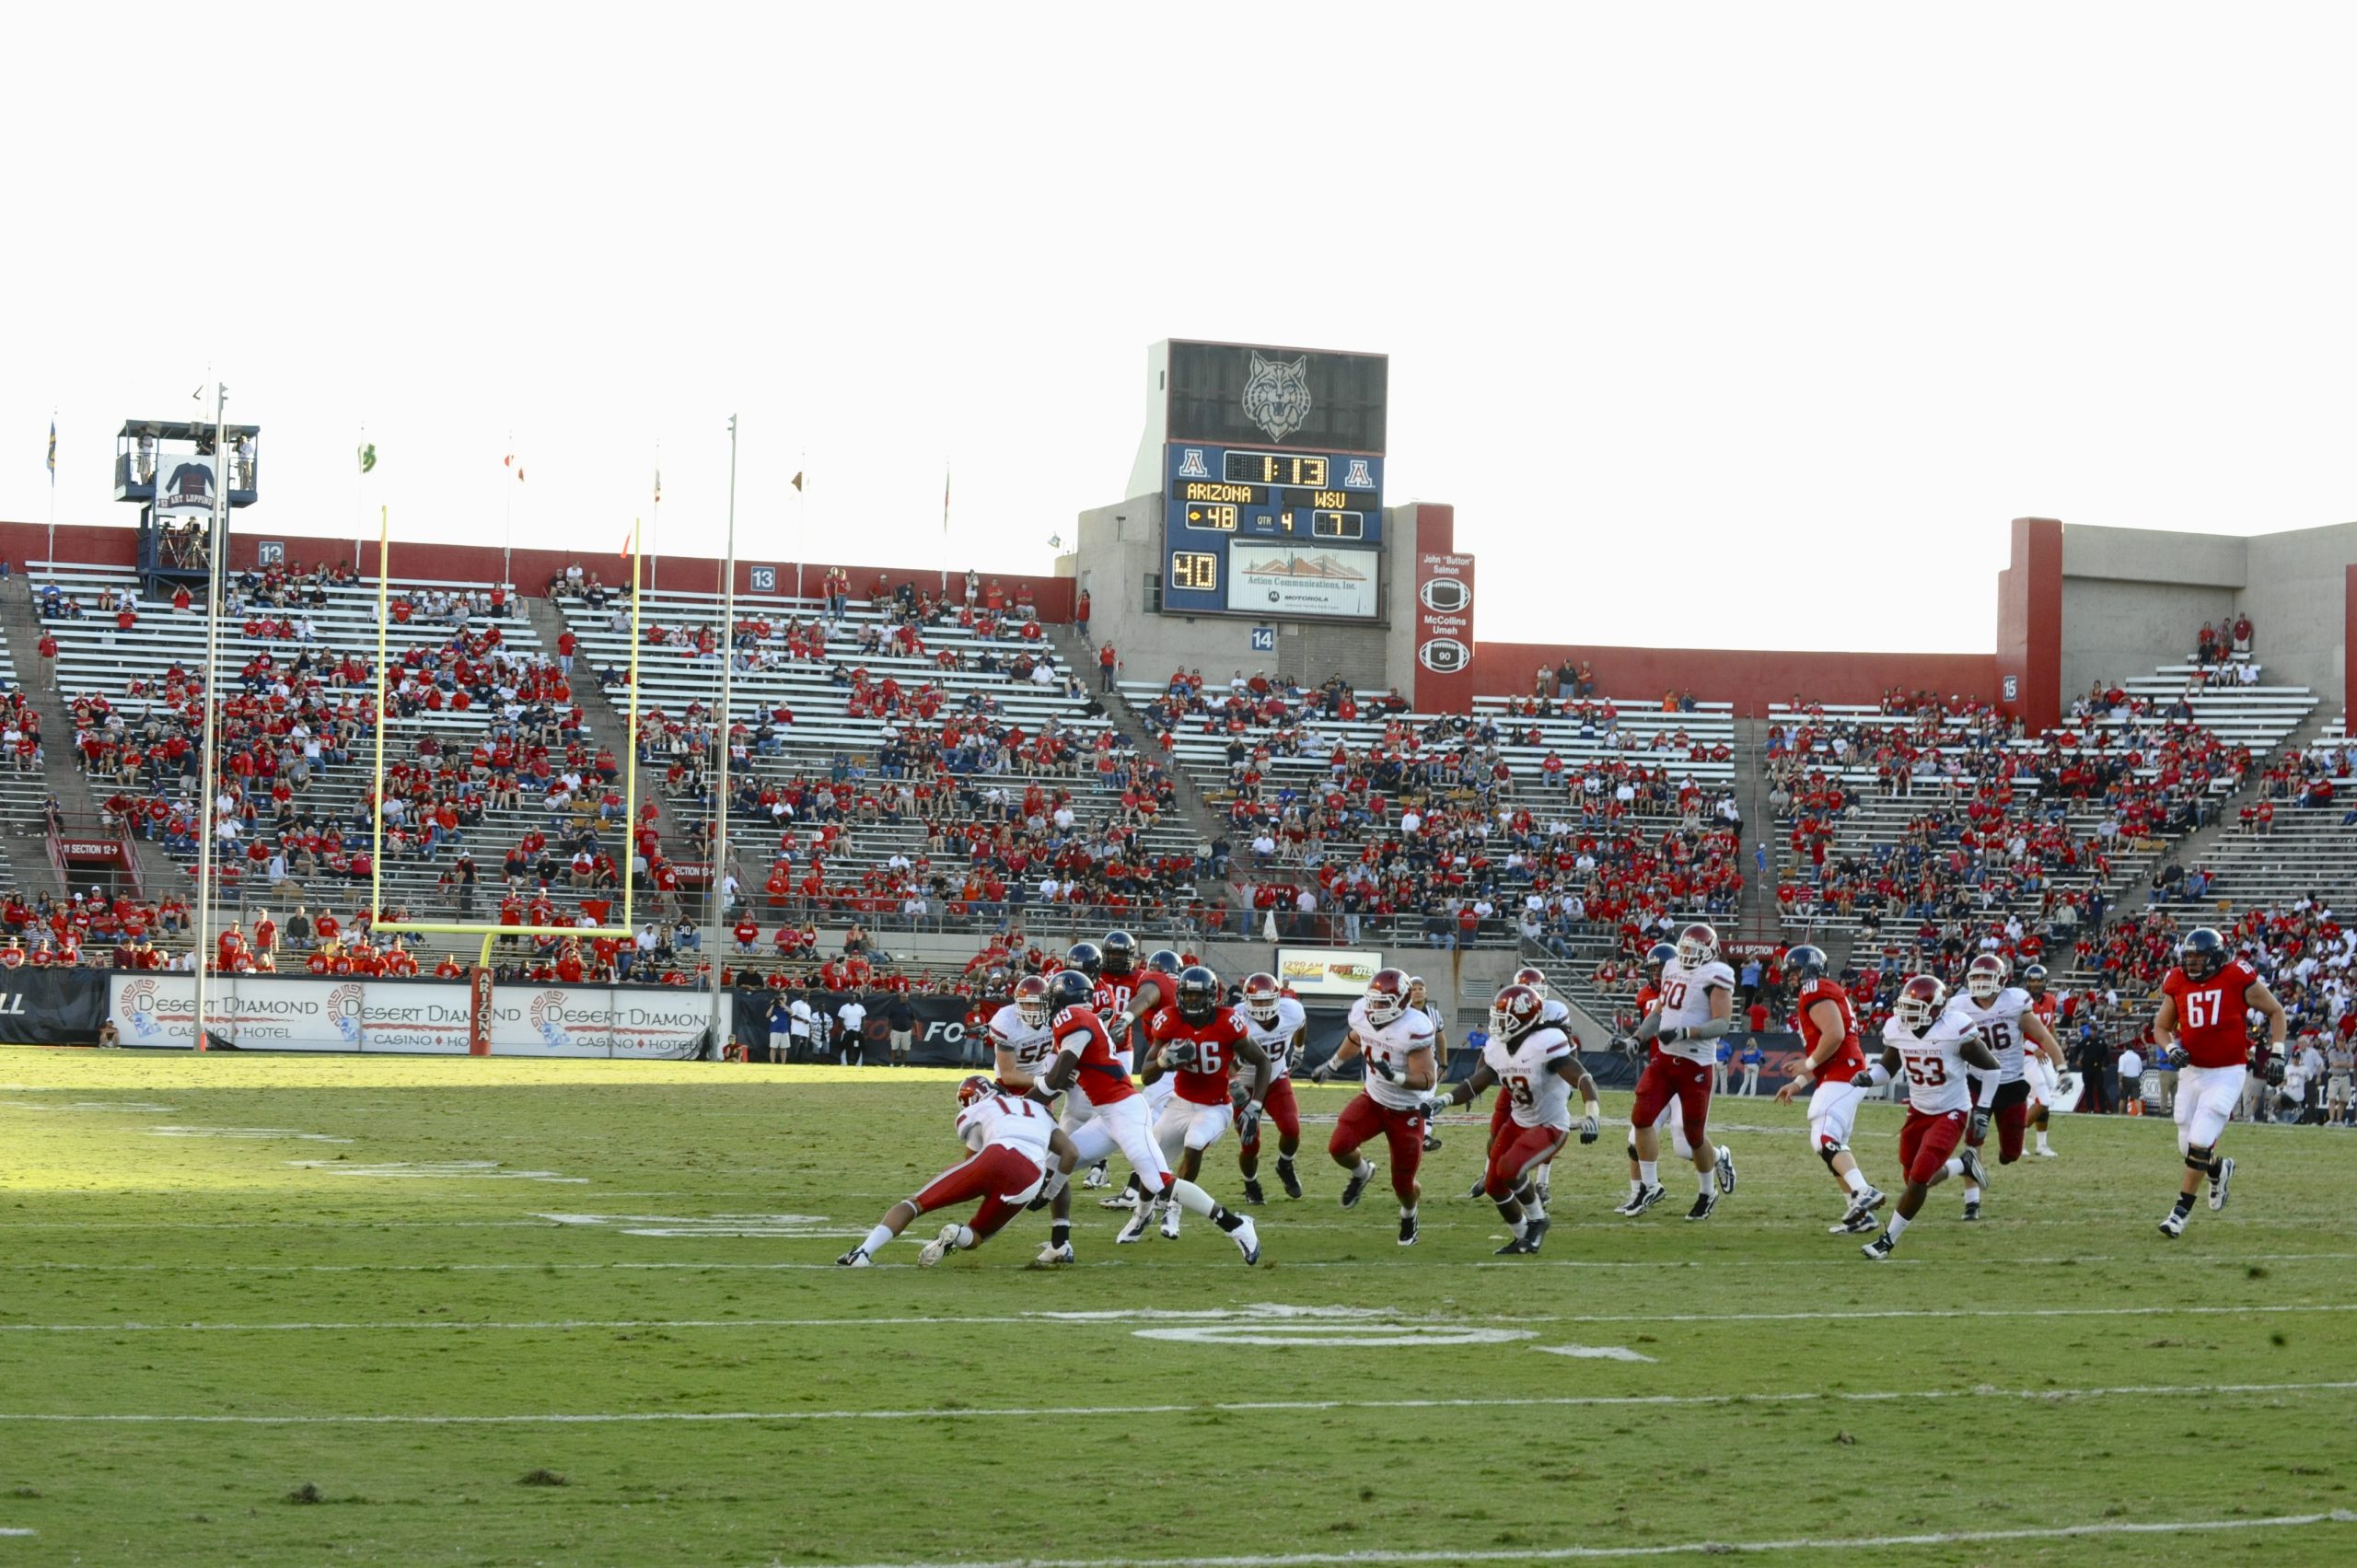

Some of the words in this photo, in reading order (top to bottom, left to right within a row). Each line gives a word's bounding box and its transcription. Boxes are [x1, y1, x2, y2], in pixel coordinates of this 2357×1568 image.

[1264, 456, 1325, 486] 1:13
[170, 494, 183, 505] ART
[1187, 482, 1252, 503] ARIZONA
[1315, 491, 1346, 507] WSU
[1207, 506, 1235, 529] 48
[1281, 513, 1293, 531] 4
[1329, 514, 1341, 536] 7
[1423, 554, 1441, 564] John
[1443, 555, 1473, 566] "Button"
[1175, 554, 1214, 587] 40
[1434, 564, 1459, 575] Salmon
[753, 570, 773, 587] 13
[1248, 575, 1272, 587] Action
[1342, 581, 1356, 590] Inc.
[1423, 615, 1467, 626] McCollins
[1433, 626, 1458, 635] Umeh
[1252, 631, 1272, 648] 14
[1439, 652, 1451, 661] 90
[2004, 679, 2016, 697] 15
[71, 844, 102, 854] SECTION
[103, 845, 110, 854] 12
[679, 924, 691, 935] 30
[1745, 945, 1774, 955] SECTION
[1660, 980, 1687, 1010] 90
[138, 994, 219, 1014] DESET
[477, 971, 493, 1041] ARIZONA
[2187, 988, 2223, 1028] 67
[427, 1005, 521, 1022] DIAMND
[168, 1026, 227, 1039] CASNO
[374, 1034, 432, 1046] CASINO
[576, 1037, 634, 1050] CASINO
[1905, 1056, 1947, 1087] 53
